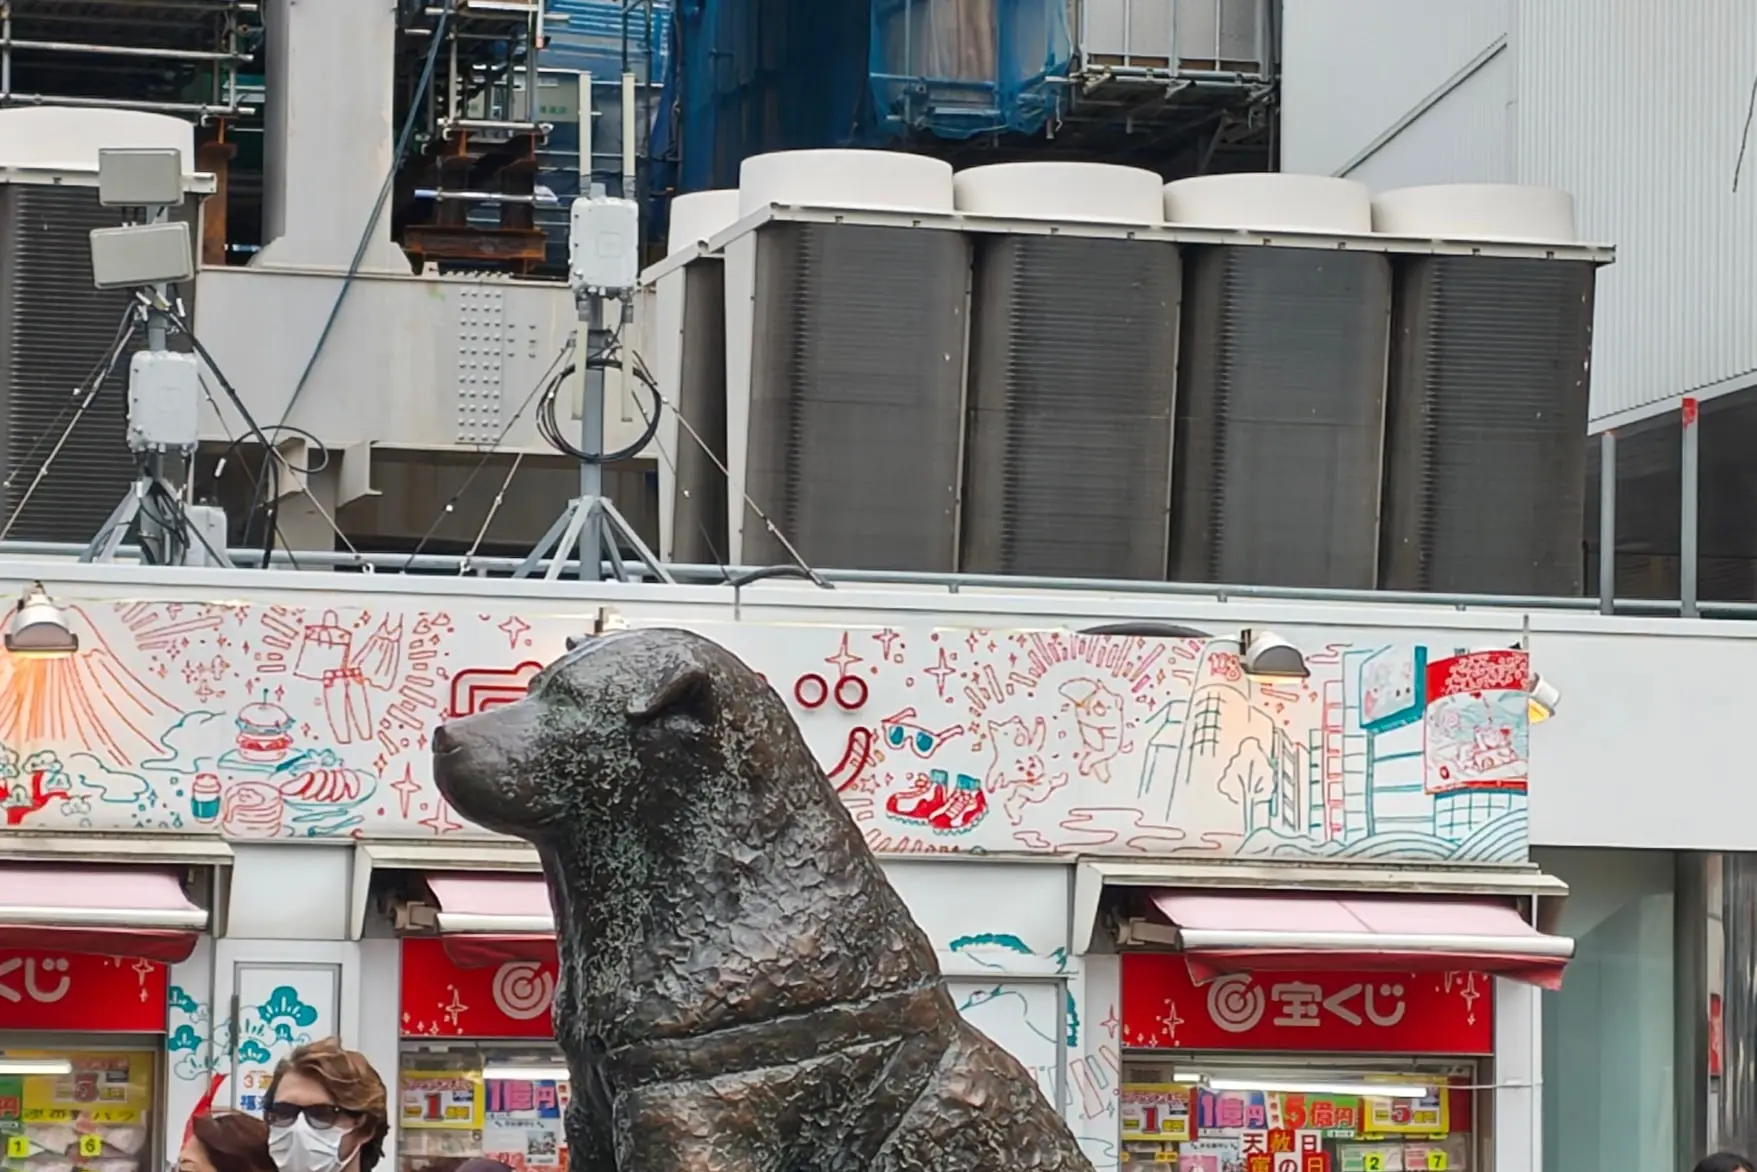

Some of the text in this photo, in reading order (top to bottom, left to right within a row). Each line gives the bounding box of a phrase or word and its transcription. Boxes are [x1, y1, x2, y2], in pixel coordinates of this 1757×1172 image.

[1272, 981, 1405, 1026] 宝くじ
[1285, 1092, 1355, 1129] 5億円
[14, 1140, 21, 1152] 1
[86, 1138, 95, 1153] 6
[1370, 1157, 1379, 1170] 2
[1433, 1155, 1441, 1168] 7
